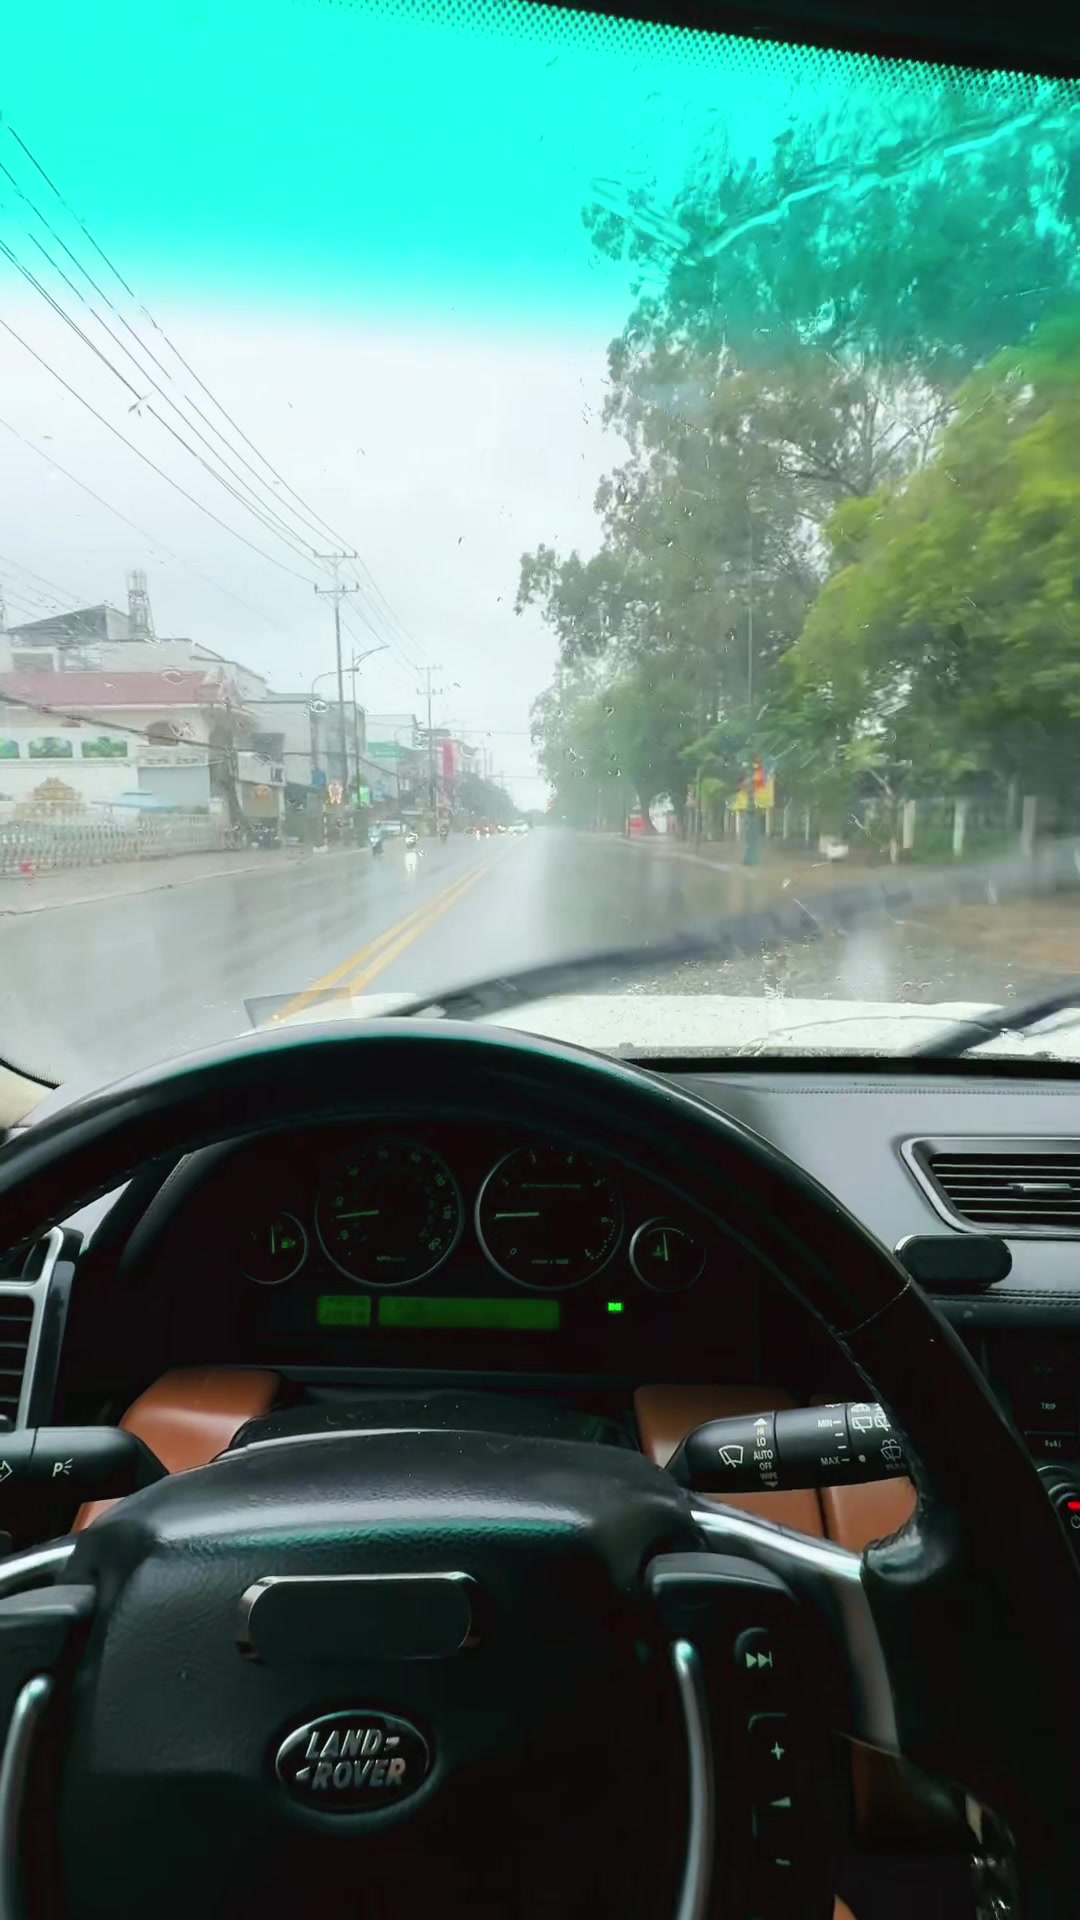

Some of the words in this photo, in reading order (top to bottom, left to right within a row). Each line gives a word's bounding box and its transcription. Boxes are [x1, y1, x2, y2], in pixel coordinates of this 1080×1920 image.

[817, 1419, 833, 1428] MIN
[756, 1437, 766, 1447] LO
[753, 1449, 774, 1460] AUTO
[759, 1462, 773, 1471] OFF
[820, 1457, 841, 1466] MAX
[305, 1728, 383, 1758] LAND
[311, 1757, 407, 1790] ROVER
